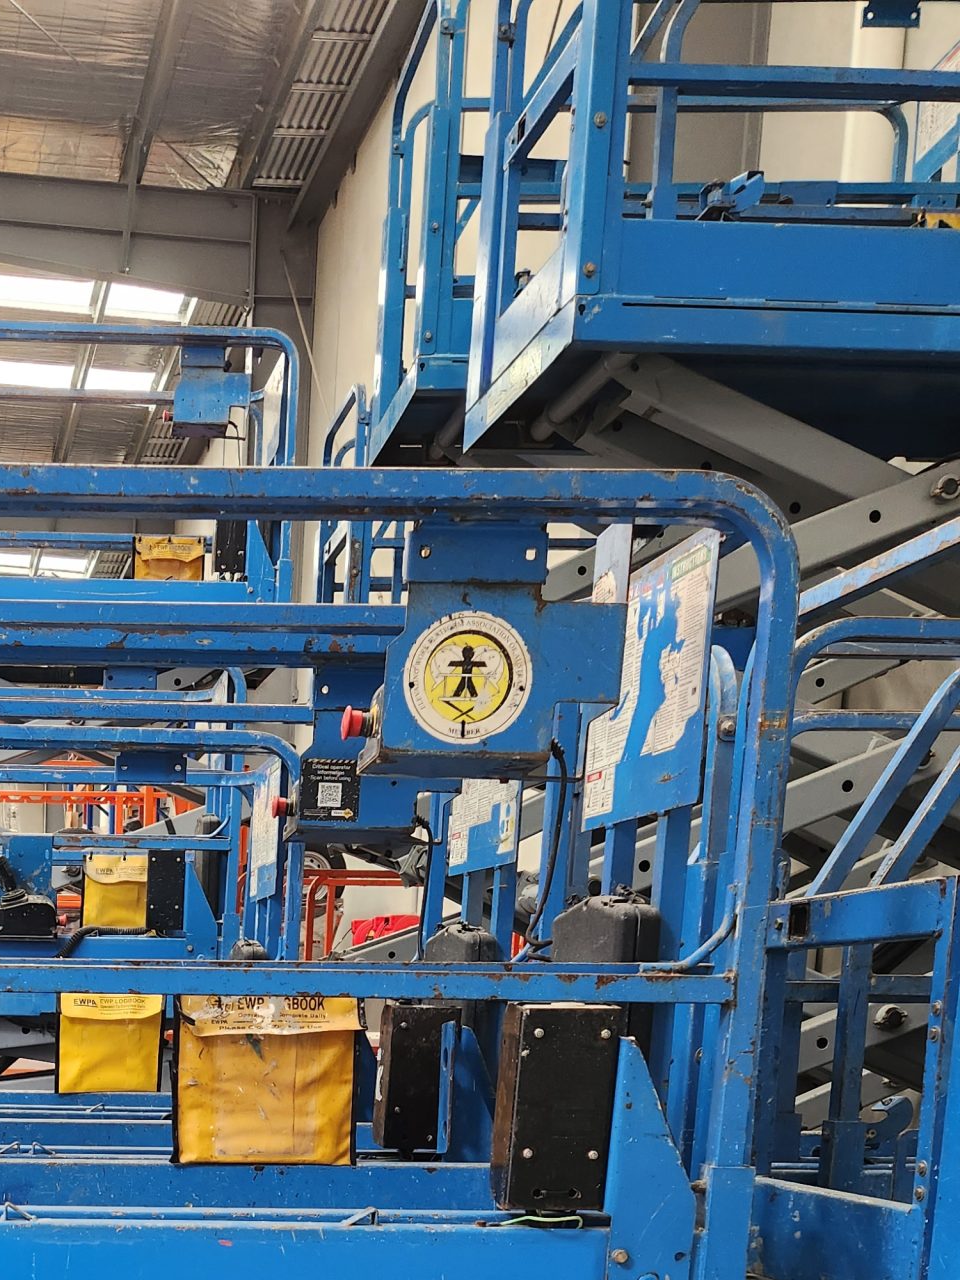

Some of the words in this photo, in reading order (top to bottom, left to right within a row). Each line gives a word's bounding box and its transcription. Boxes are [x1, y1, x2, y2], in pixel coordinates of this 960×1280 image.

[467, 619, 512, 643] ASSOCIATION
[448, 727, 481, 736] MEBER
[73, 998, 97, 1006] EWPA
[283, 996, 326, 1011] GBOOK
